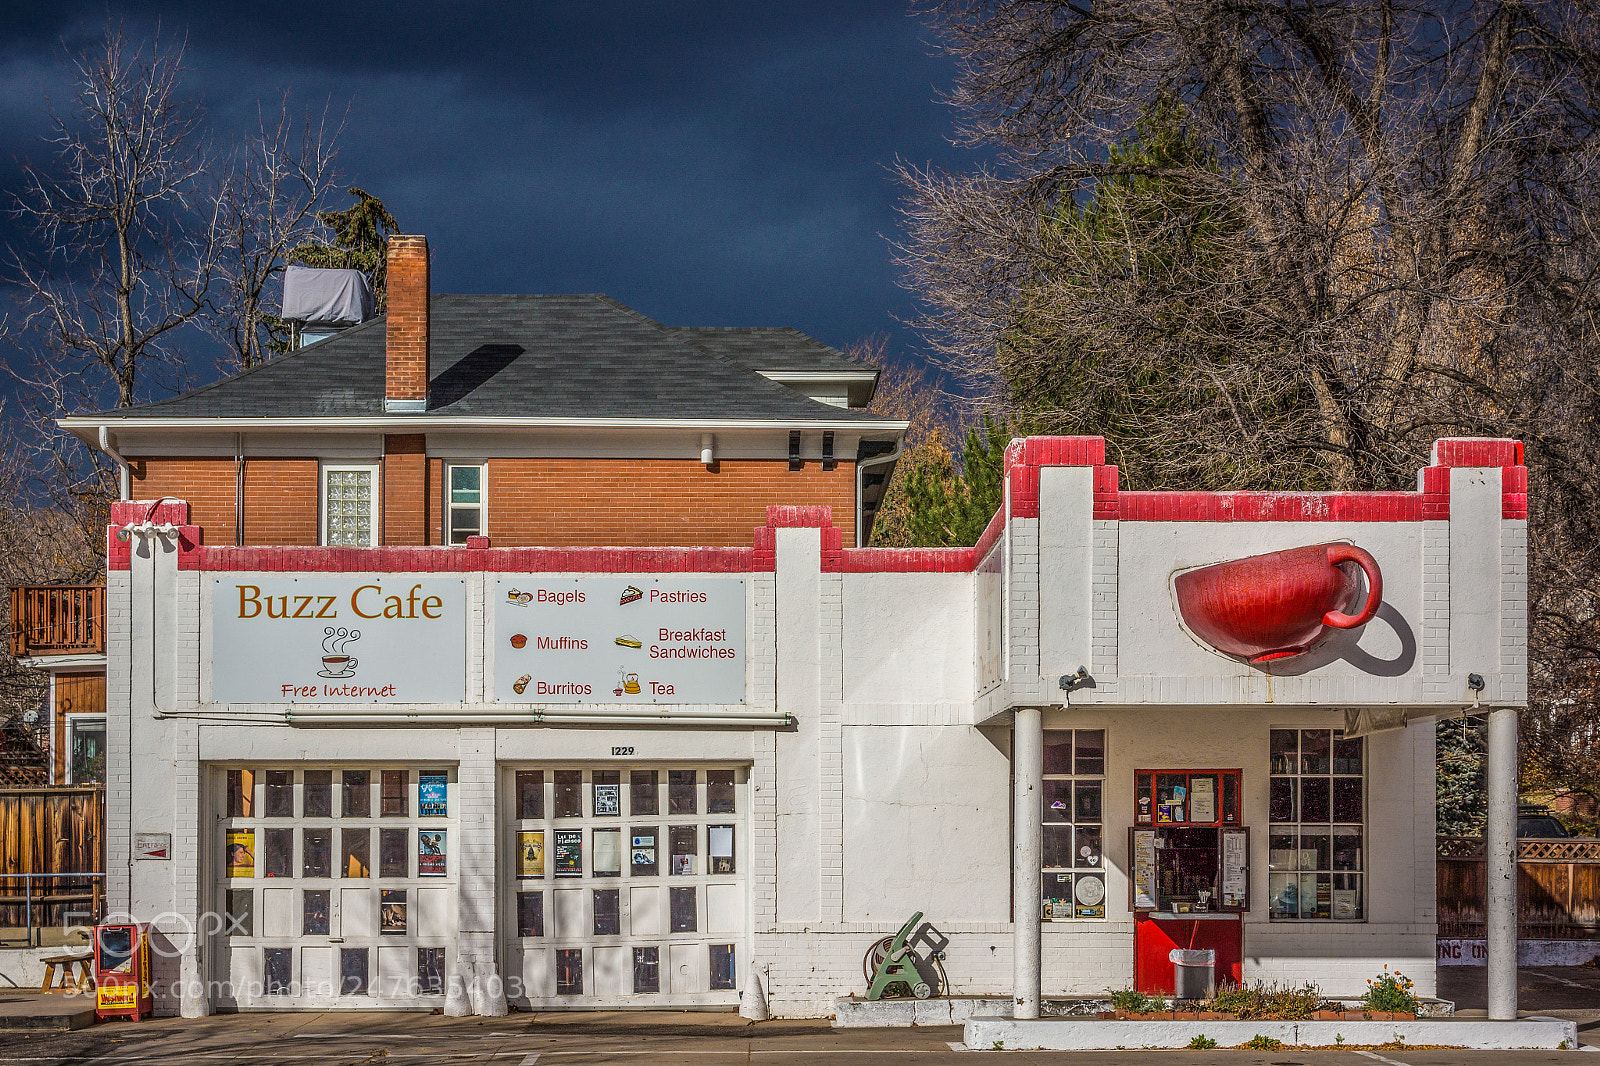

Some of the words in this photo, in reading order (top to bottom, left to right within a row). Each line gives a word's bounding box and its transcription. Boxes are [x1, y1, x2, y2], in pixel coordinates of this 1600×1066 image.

[235, 584, 338, 619] Buzz
[350, 584, 443, 619] Cafe
[537, 589, 586, 606] Bagels
[649, 589, 707, 603] Pastries
[659, 628, 726, 642] Breakfast
[537, 636, 588, 650] Muffins
[649, 645, 736, 659] Sandwiches
[281, 684, 317, 698] Free
[323, 684, 396, 697] Internet
[537, 682, 592, 695] Burritos
[649, 682, 675, 695] Tea
[611, 746, 635, 756] 1229
